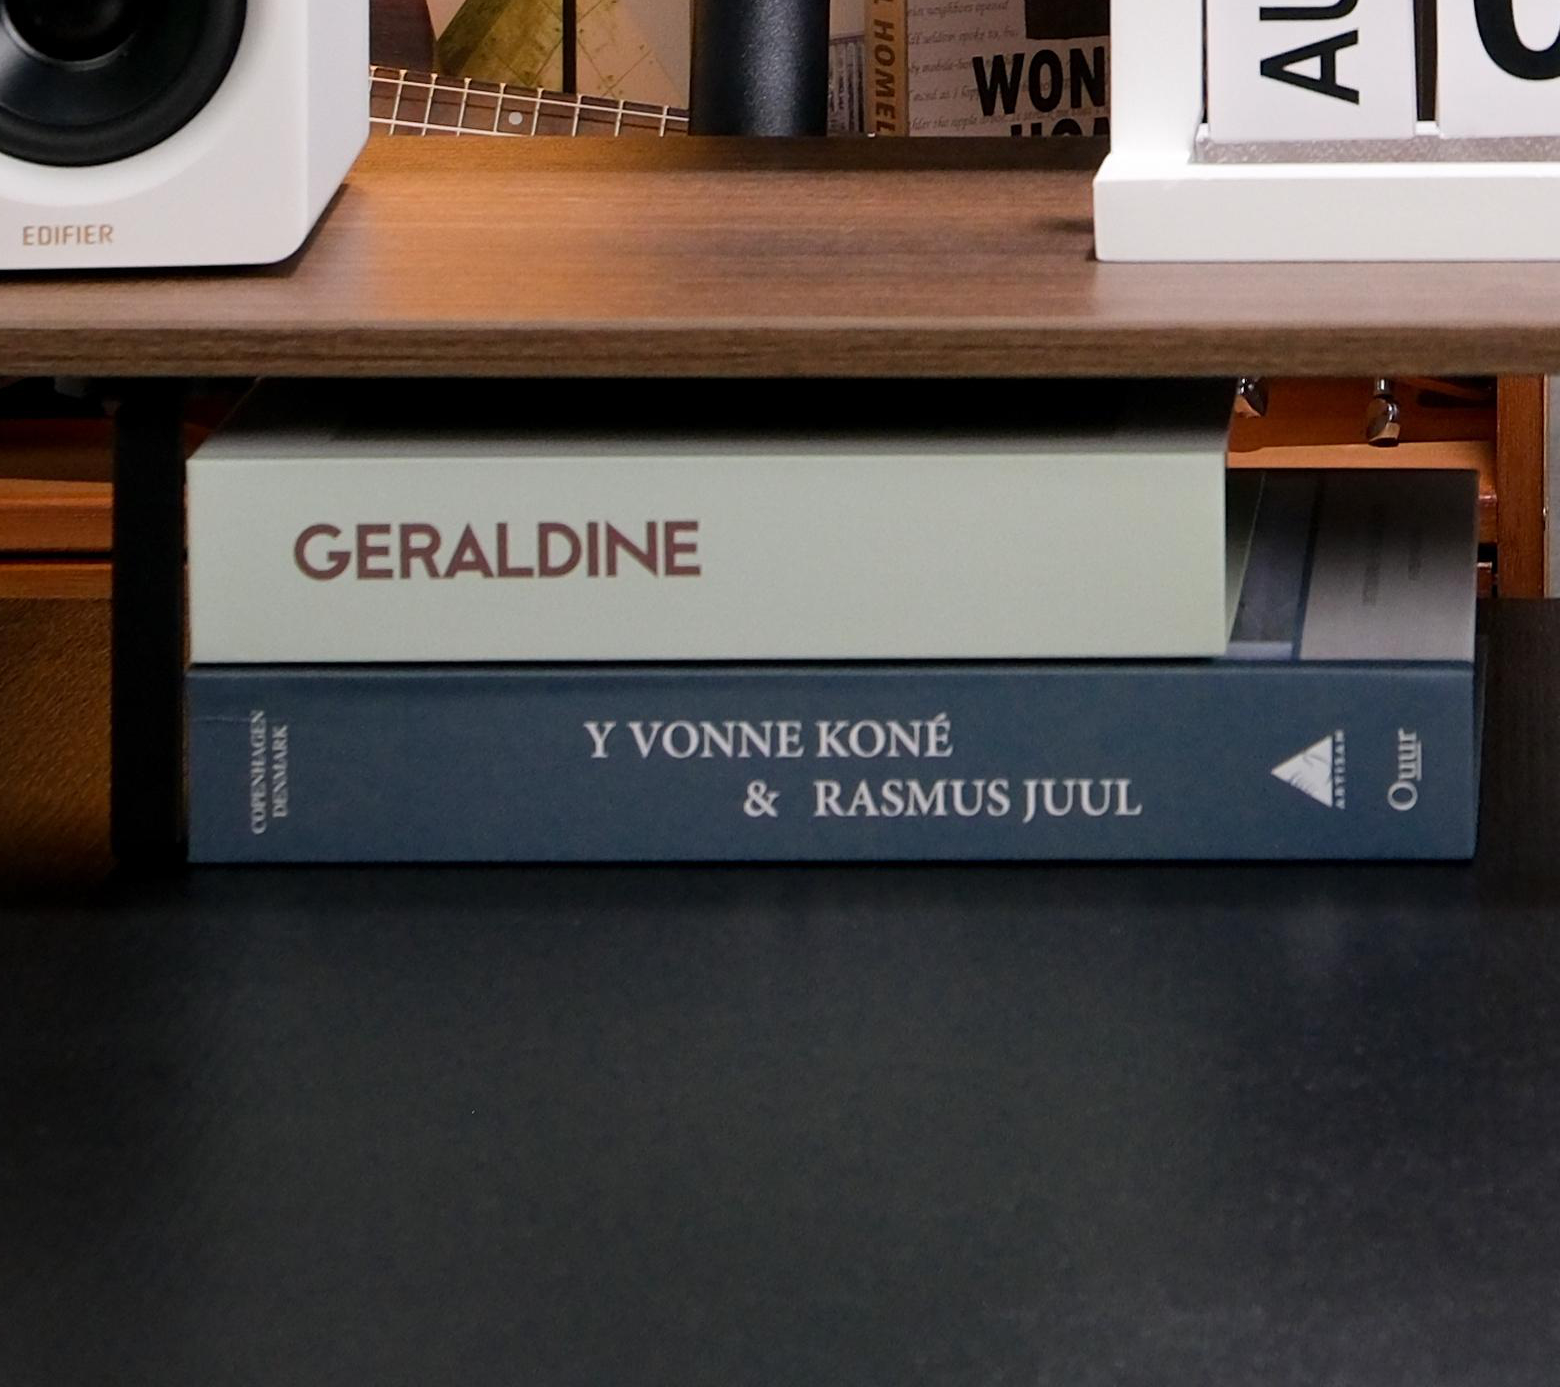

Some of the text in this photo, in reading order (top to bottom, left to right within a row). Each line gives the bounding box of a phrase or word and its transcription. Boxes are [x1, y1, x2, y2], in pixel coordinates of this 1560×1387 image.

[972, 46, 1105, 116] WON
[22, 224, 115, 246] EDIFIER
[291, 519, 703, 583] GERALDINE
[816, 712, 953, 758] KONÉ
[1334, 730, 1346, 810] ARTISAN
[1387, 727, 1422, 812] Ouur
[250, 710, 267, 834] COPENHAGEN
[272, 725, 288, 818] DENMARK
[743, 778, 1142, 823] & RASMUS JUUL
